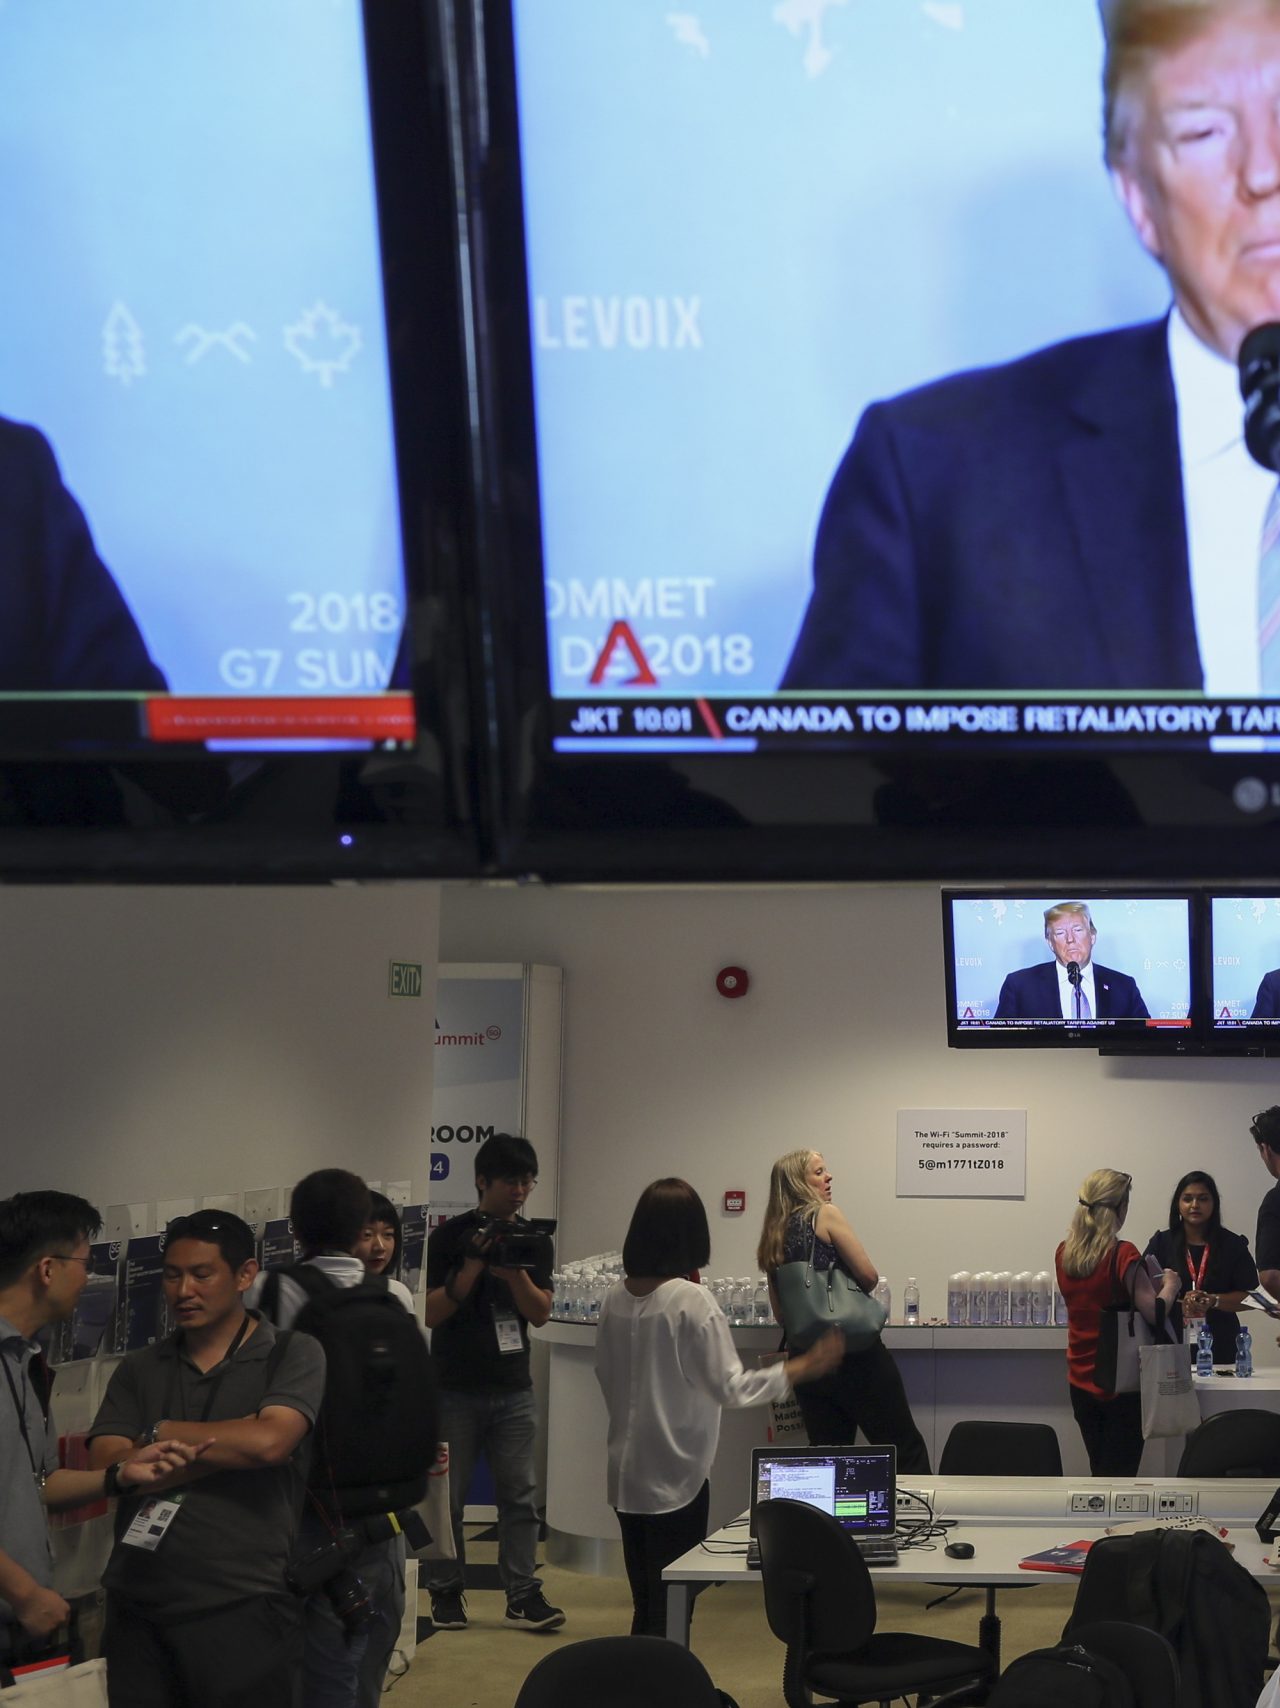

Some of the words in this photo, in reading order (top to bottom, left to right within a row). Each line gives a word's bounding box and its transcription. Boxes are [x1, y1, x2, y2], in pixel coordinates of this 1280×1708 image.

[536, 295, 703, 349] LEVOIX
[288, 592, 400, 633] 2018
[218, 649, 282, 689] G7
[648, 634, 755, 676] 2018
[571, 706, 623, 733] JKT
[726, 706, 854, 732] CANADA
[858, 706, 901, 732] TO
[906, 706, 1019, 732] IMPOSE
[1024, 706, 1222, 732] RETALIATORY
[392, 965, 417, 994] EXIT
[431, 1125, 495, 1144] OOM
[914, 1131, 929, 1139] The
[930, 1131, 950, 1139] Wi-Fi
[922, 1141, 954, 1150] requires
[961, 1141, 1001, 1150] password:
